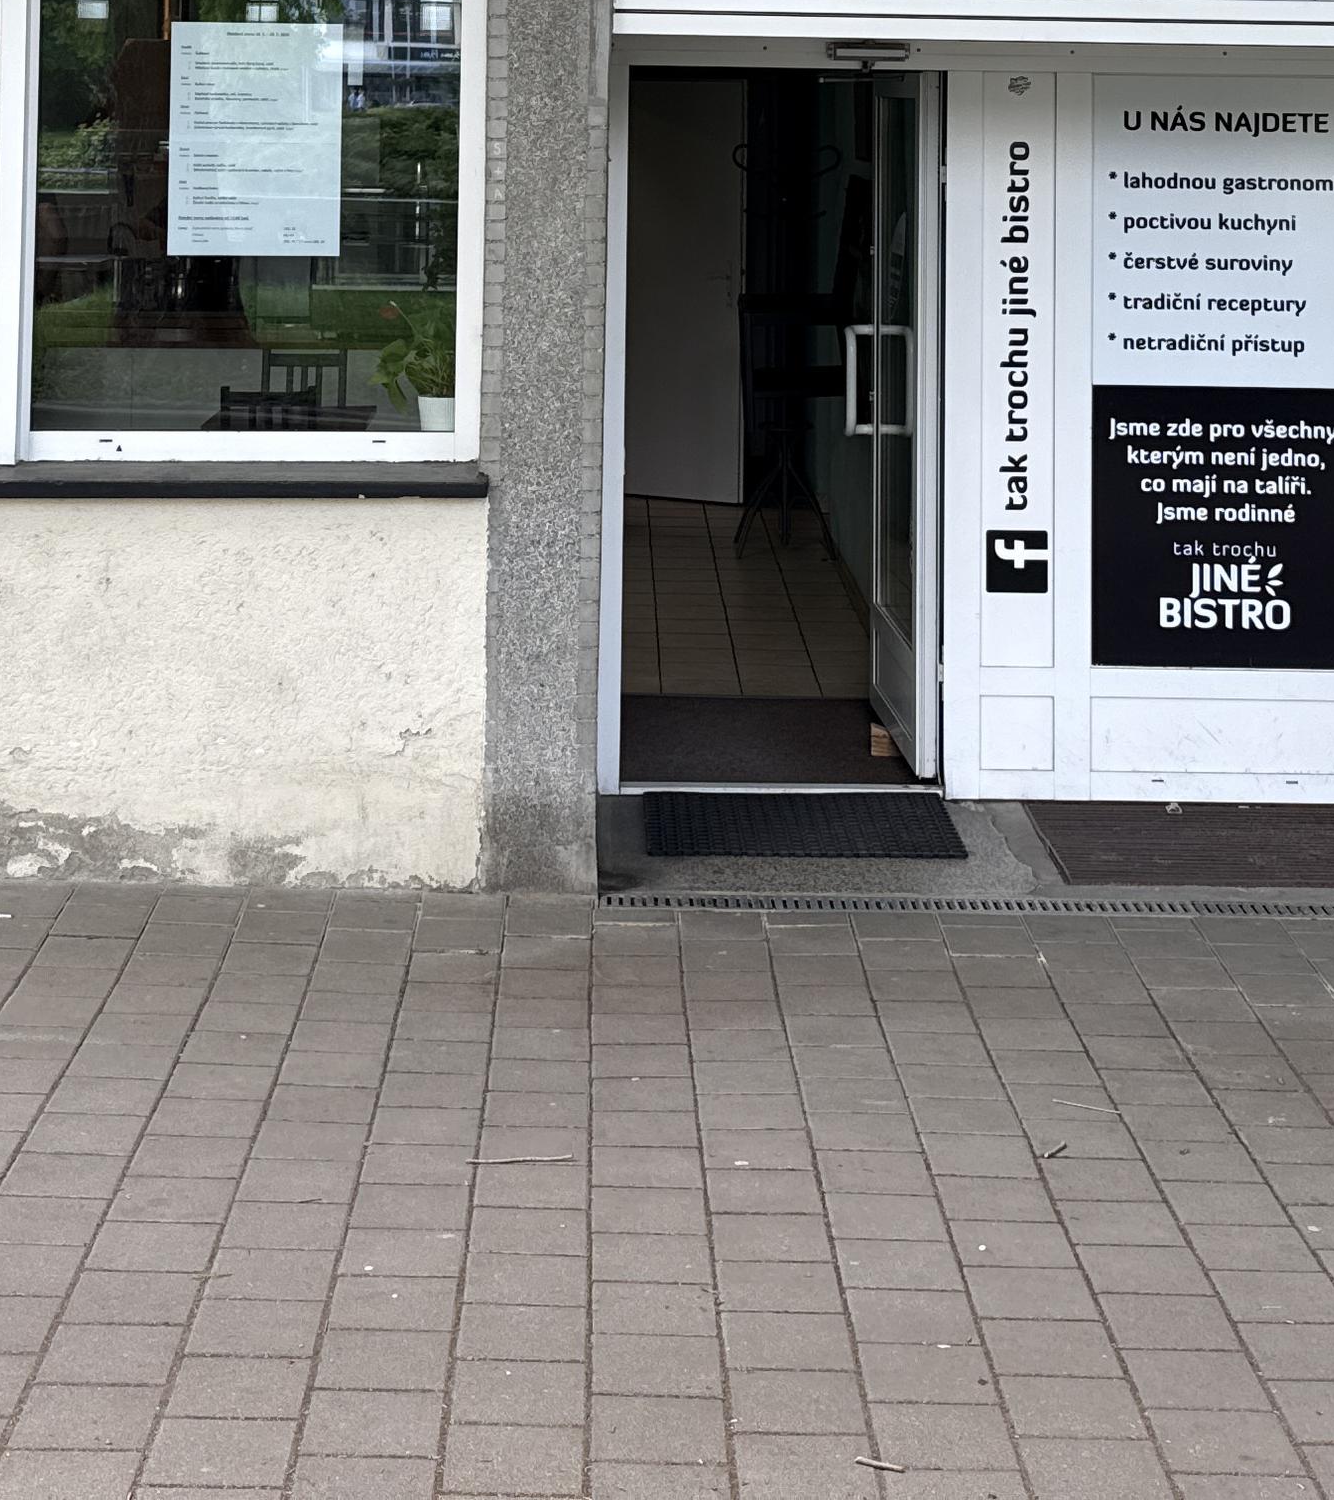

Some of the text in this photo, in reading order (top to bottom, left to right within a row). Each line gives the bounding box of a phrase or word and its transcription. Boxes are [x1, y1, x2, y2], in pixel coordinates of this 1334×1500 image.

[1123, 106, 1329, 137] U NÁS NAJDETE
[1123, 171, 1216, 190] lahodnou
[1124, 213, 1296, 235] poctivou kuchyni
[1123, 252, 1293, 276] čerstvé suroviny
[1123, 293, 1306, 315] tradiční receptury
[999, 141, 1036, 510] tak trochu jiné bistro
[1123, 333, 1305, 356] netradiční přístup
[1109, 418, 1161, 440] Jsme
[1167, 419, 1203, 437] zde
[1210, 424, 1244, 441] pro
[1127, 446, 1325, 471] kterým není jedno,
[1141, 476, 1311, 498] co mají na talíři.
[1156, 502, 1295, 523] Jsme rodinné
[1173, 541, 1276, 557] tak trochu
[1189, 556, 1262, 598] JINÉ
[1159, 597, 1291, 630] BISTRO
